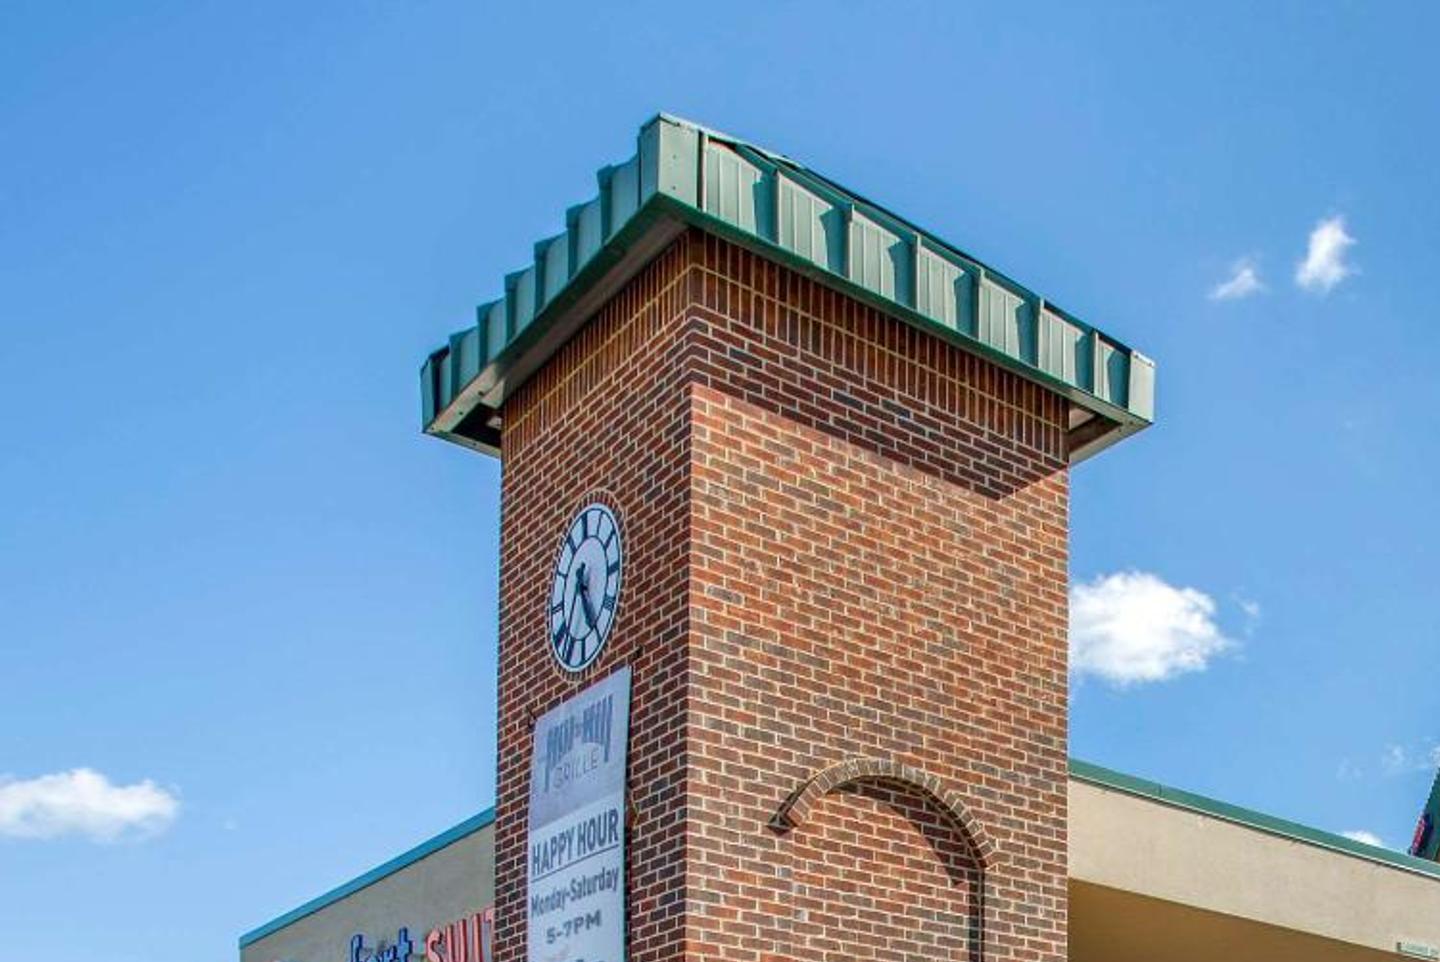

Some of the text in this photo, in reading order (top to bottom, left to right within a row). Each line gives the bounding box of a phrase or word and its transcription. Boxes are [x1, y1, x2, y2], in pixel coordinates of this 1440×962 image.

[531, 807, 619, 876] HAPPY HOUR
[545, 909, 602, 945] 5-7PM
